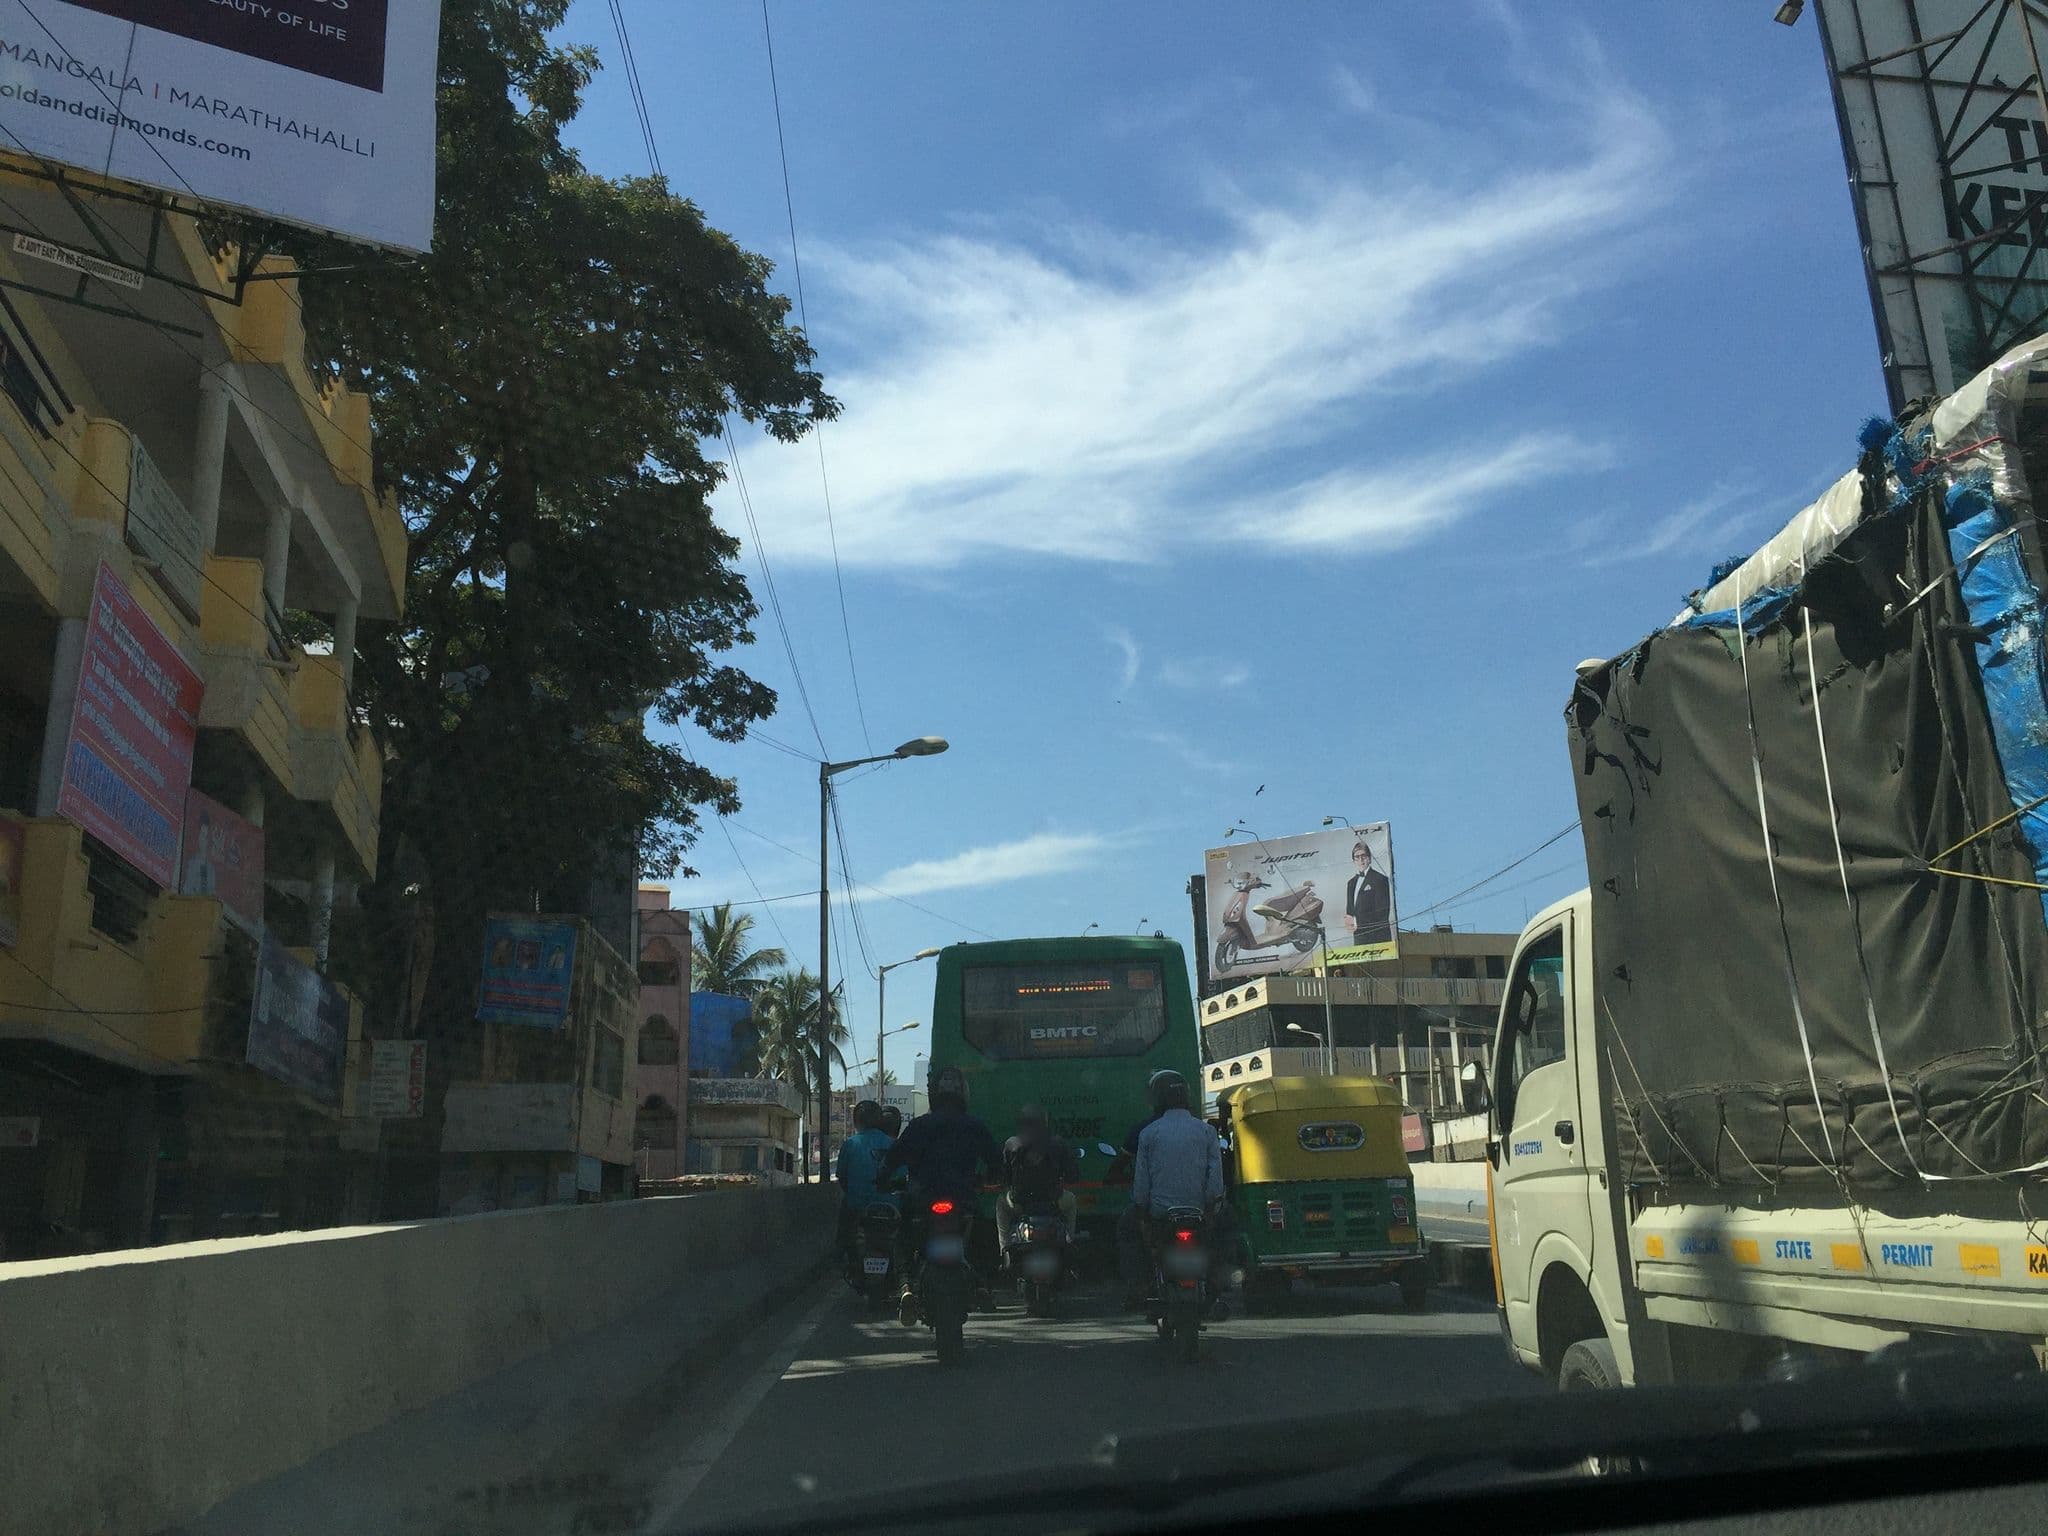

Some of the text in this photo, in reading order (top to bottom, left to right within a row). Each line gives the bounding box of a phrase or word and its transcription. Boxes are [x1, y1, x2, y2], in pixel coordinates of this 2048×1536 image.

[209, 0, 348, 41] AUTY OF LIFE
[0, 39, 375, 158] MANGALA MARATHAHALLI
[0, 84, 251, 161] oldanddiamonds.com
[1327, 948, 1389, 961] Jupiter
[1030, 1025, 1097, 1039] BMTC
[1775, 1240, 1813, 1260] STATE
[1881, 1243, 1934, 1267] PERMIT
